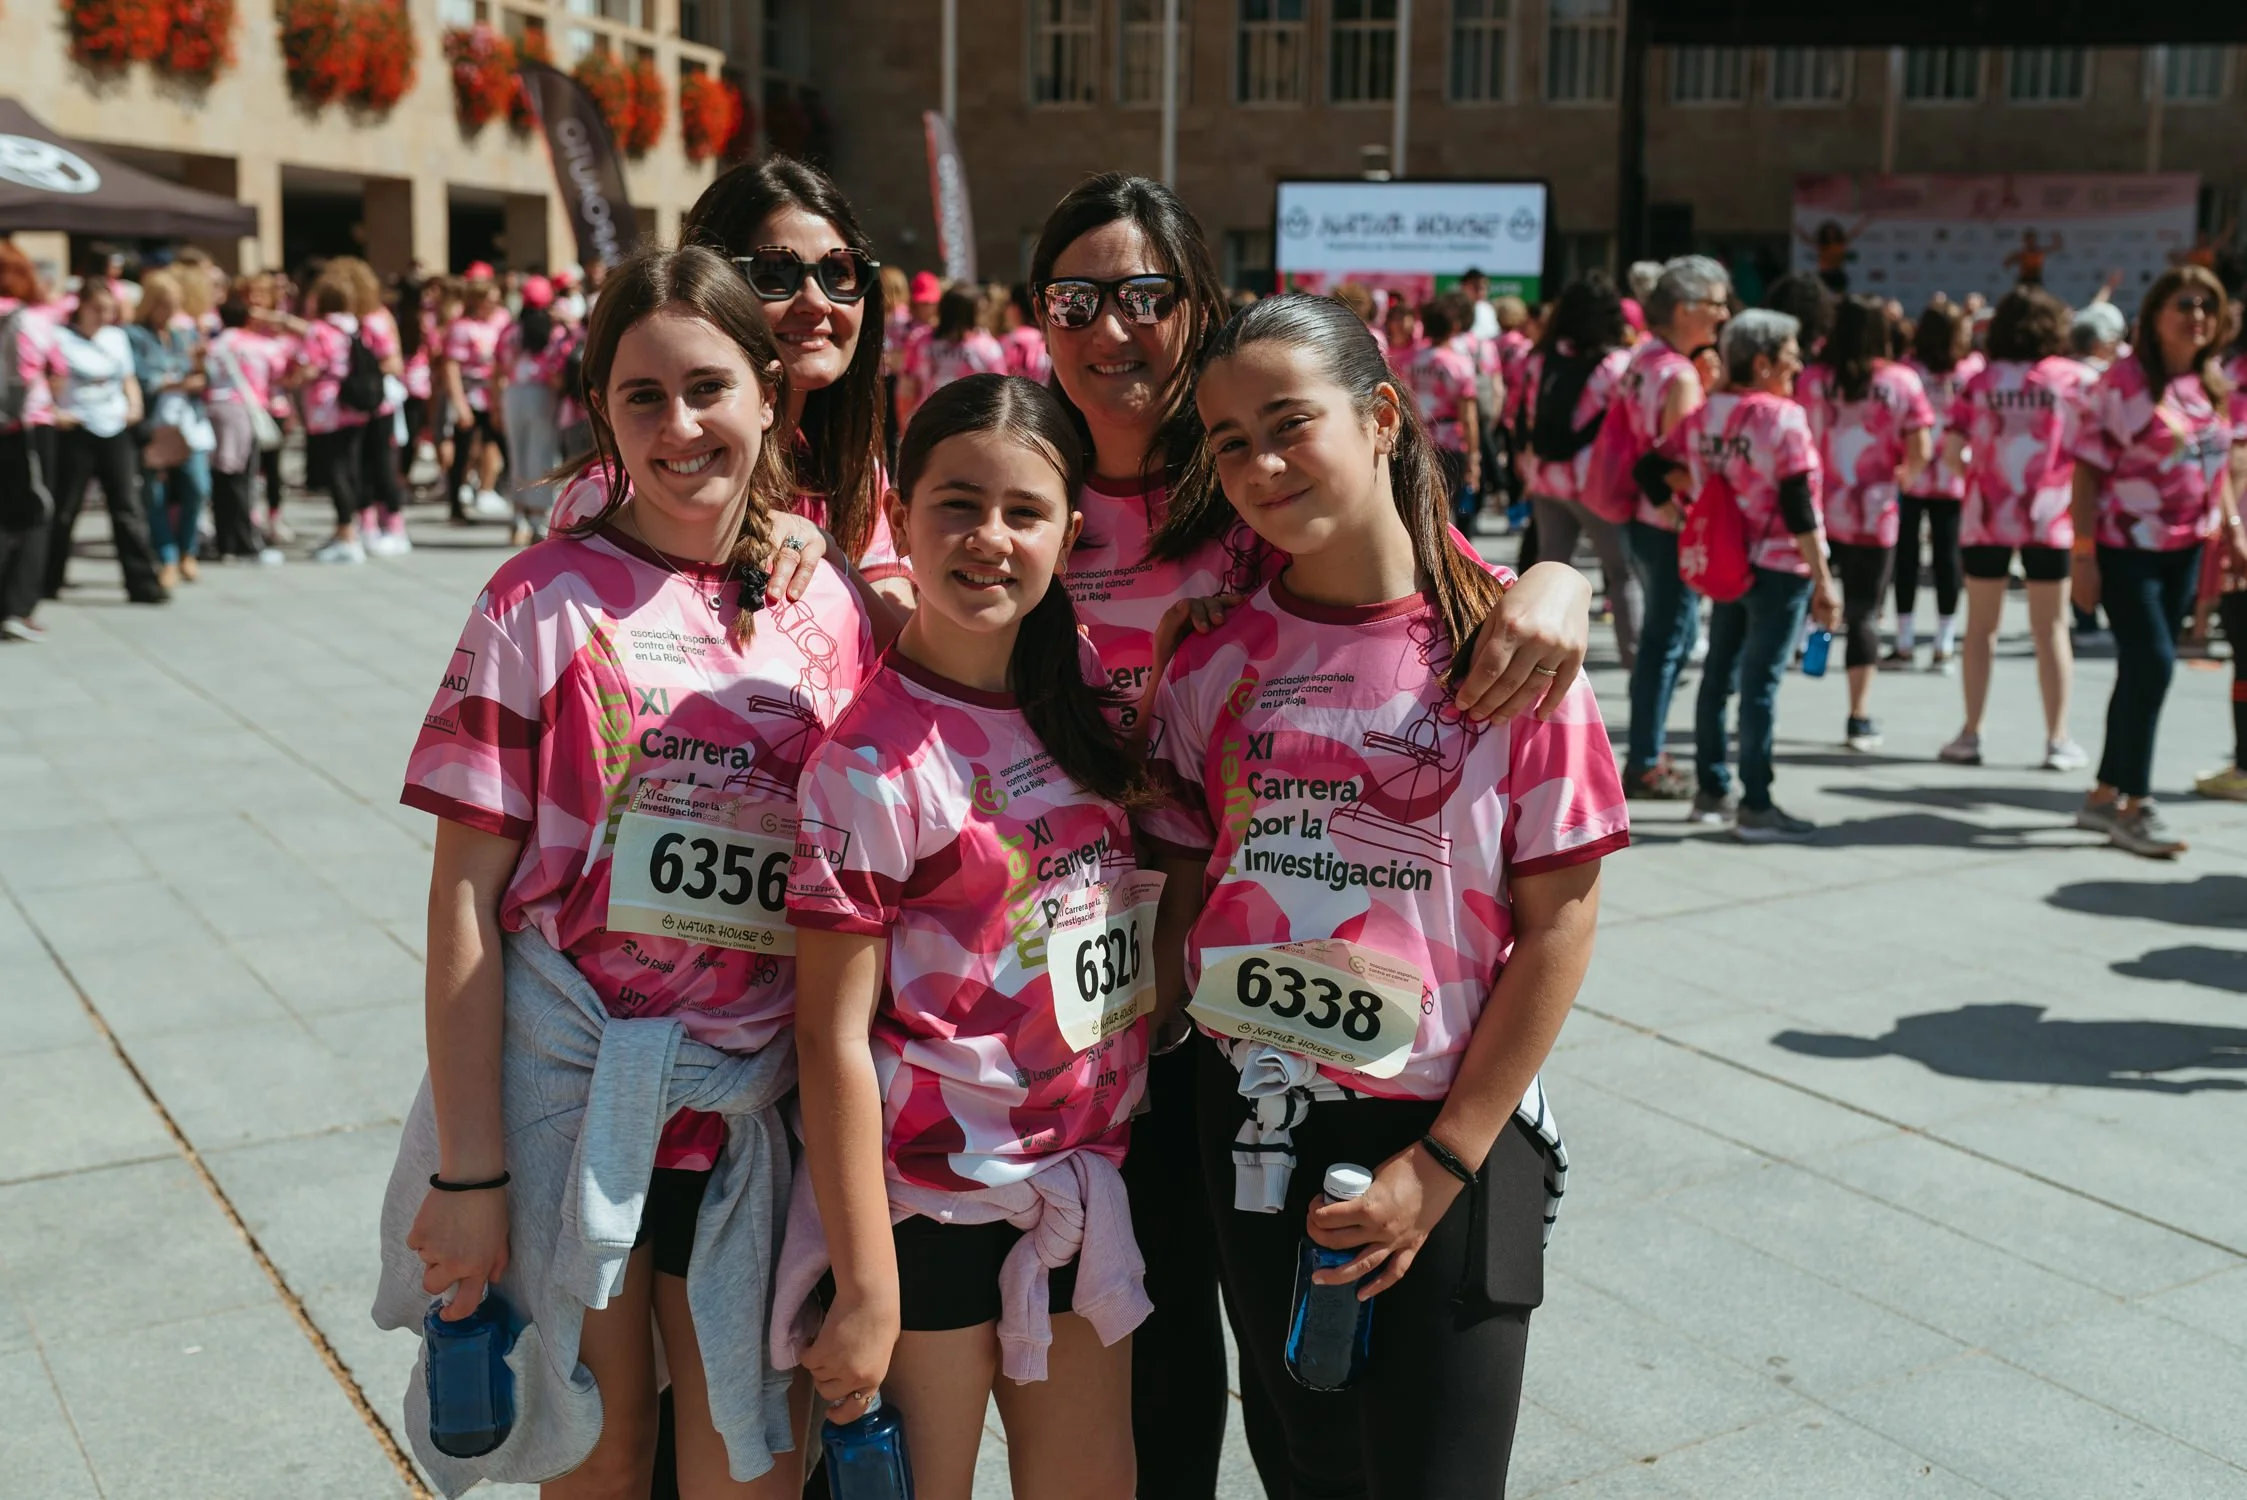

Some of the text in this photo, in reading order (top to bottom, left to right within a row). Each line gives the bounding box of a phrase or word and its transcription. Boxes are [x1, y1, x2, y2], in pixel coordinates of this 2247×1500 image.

[1089, 592, 1111, 603] Rioja
[630, 629, 725, 645] asociación española
[633, 640, 664, 650] contra
[667, 642, 674, 651] el
[635, 651, 686, 665] en La Rioja
[1266, 672, 1355, 687] asociación española
[635, 687, 671, 716] XI
[1260, 695, 1306, 709] en La Rioja
[1262, 688, 1290, 697] contra
[639, 727, 750, 770] Carrera
[1244, 732, 1274, 761] XI
[1000, 757, 1034, 778] asociación
[1006, 772, 1028, 788] contra
[1012, 788, 1022, 798] en
[1020, 784, 1031, 794] La
[1247, 771, 1358, 803] Carrera
[640, 800, 703, 819] investigación
[643, 787, 720, 811] XI Carrera por la
[1025, 815, 1055, 851] XI
[1244, 809, 1323, 845] por la
[650, 832, 791, 912] 6356
[1243, 848, 1432, 892] investigación
[1065, 903, 1088, 916] Carrera
[676, 919, 760, 942] NATUR HOUSE
[636, 950, 650, 966] La
[649, 958, 676, 974] Rioja
[1076, 919, 1141, 1002] 6326
[1237, 957, 1383, 1042] 6338
[1253, 1026, 1340, 1057] NATUR HOUSE
[1032, 1062, 1073, 1082] Logroño
